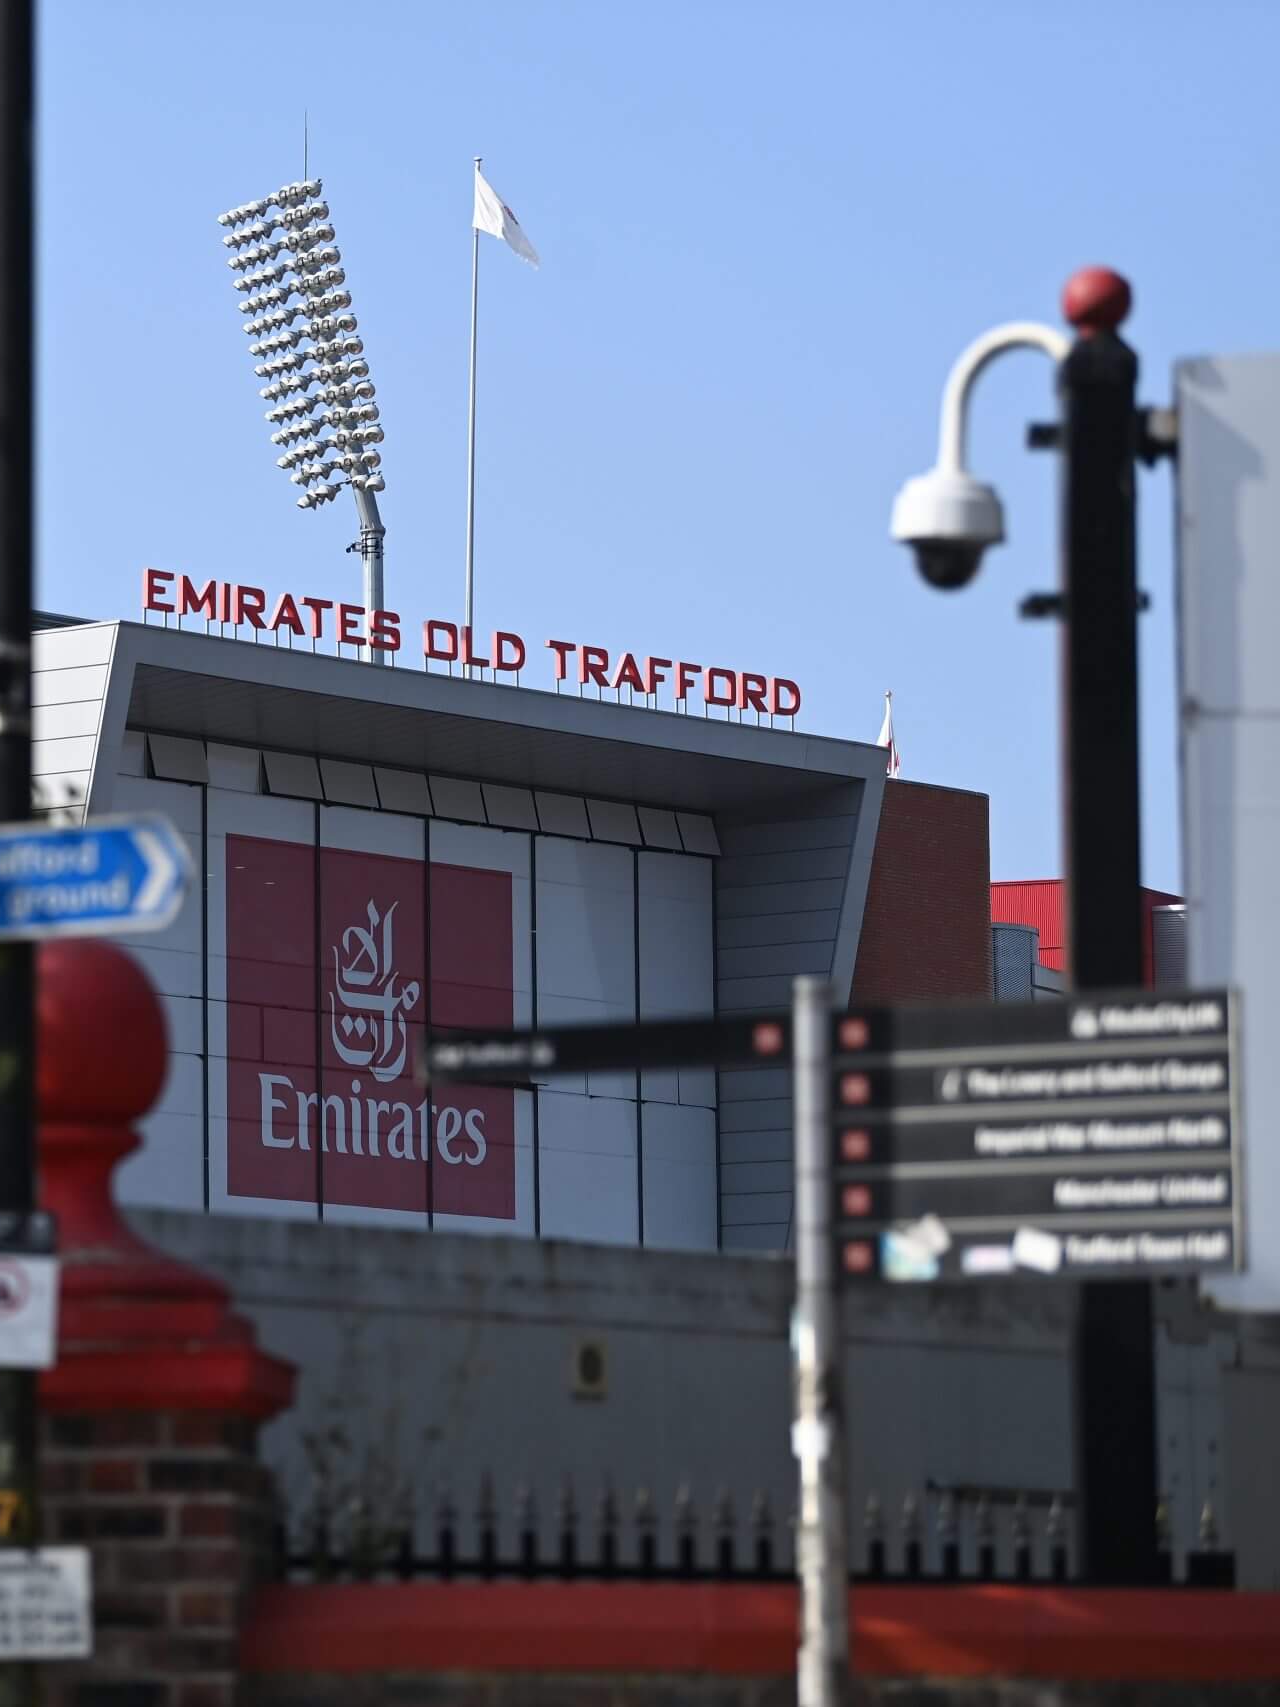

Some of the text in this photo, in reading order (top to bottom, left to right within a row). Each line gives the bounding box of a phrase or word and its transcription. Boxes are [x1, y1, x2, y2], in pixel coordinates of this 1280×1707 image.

[142, 567, 802, 717] EMIRATES OLD TRAFFORD
[257, 1078, 488, 1166] Emirates
